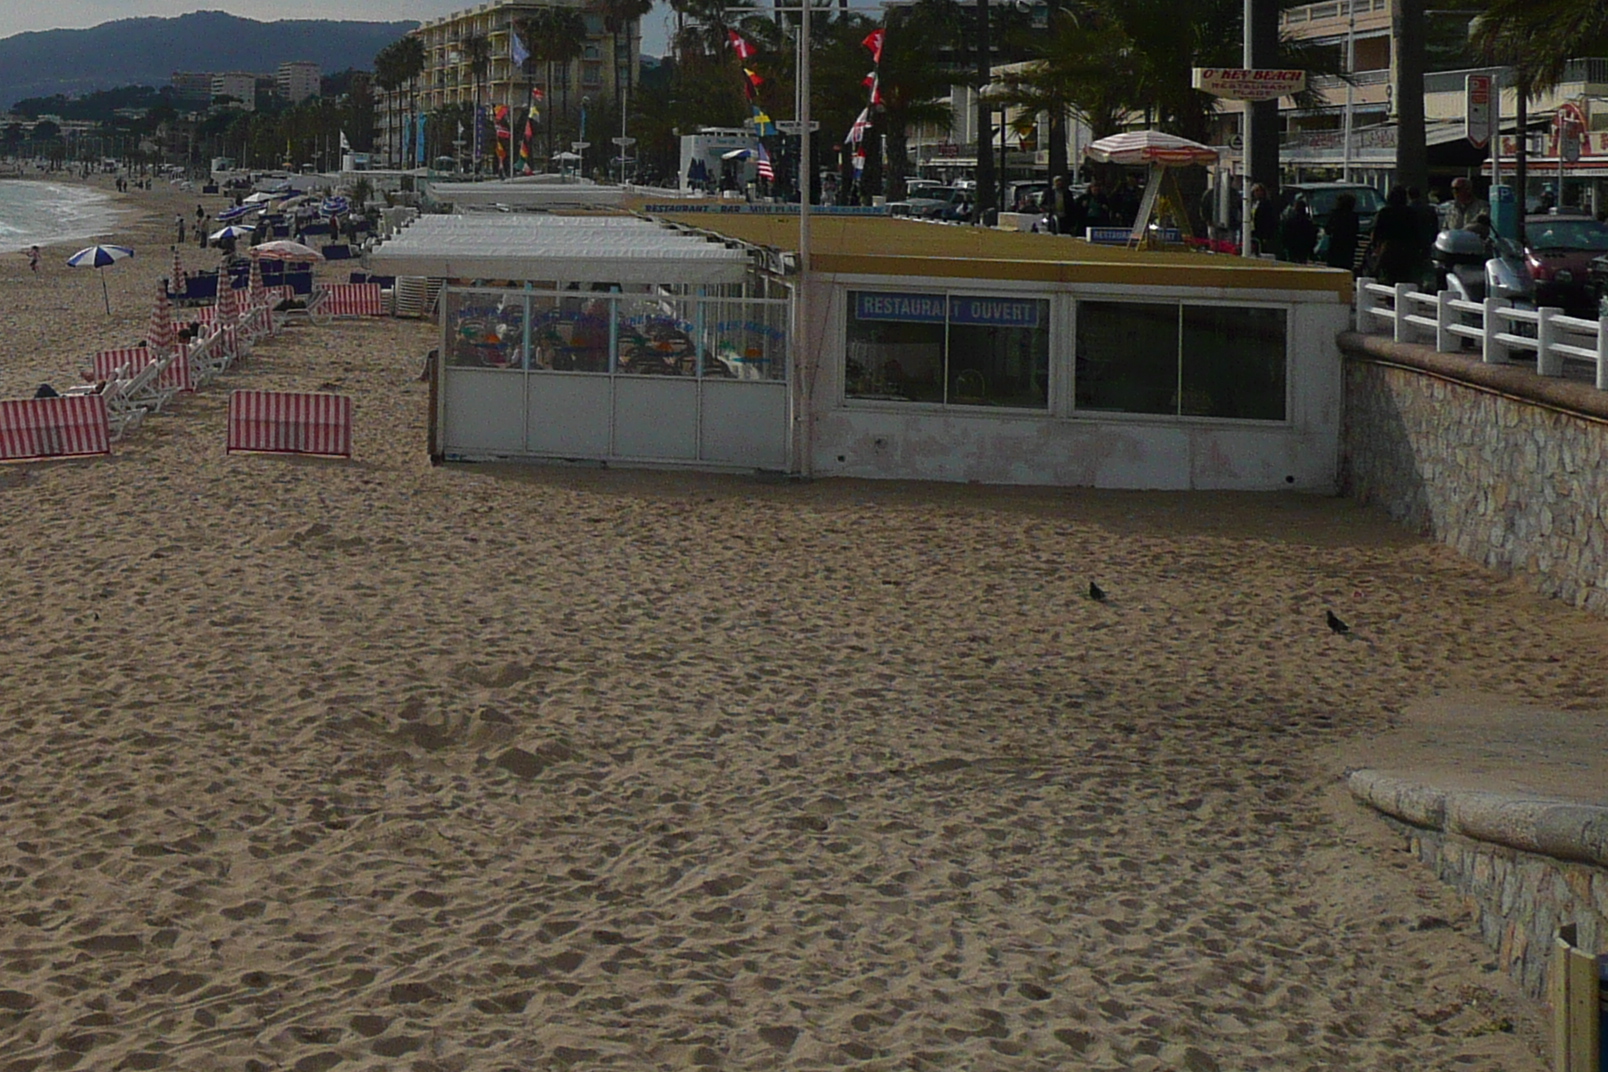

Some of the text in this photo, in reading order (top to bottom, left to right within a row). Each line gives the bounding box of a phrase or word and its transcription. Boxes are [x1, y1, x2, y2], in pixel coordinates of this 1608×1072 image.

[1221, 69, 1252, 80] KEY
[1253, 70, 1302, 81] BEACH
[644, 203, 710, 214] RESTAURANT
[720, 205, 741, 214] BAR
[864, 295, 1031, 321] RESTAURANT OUVERT
